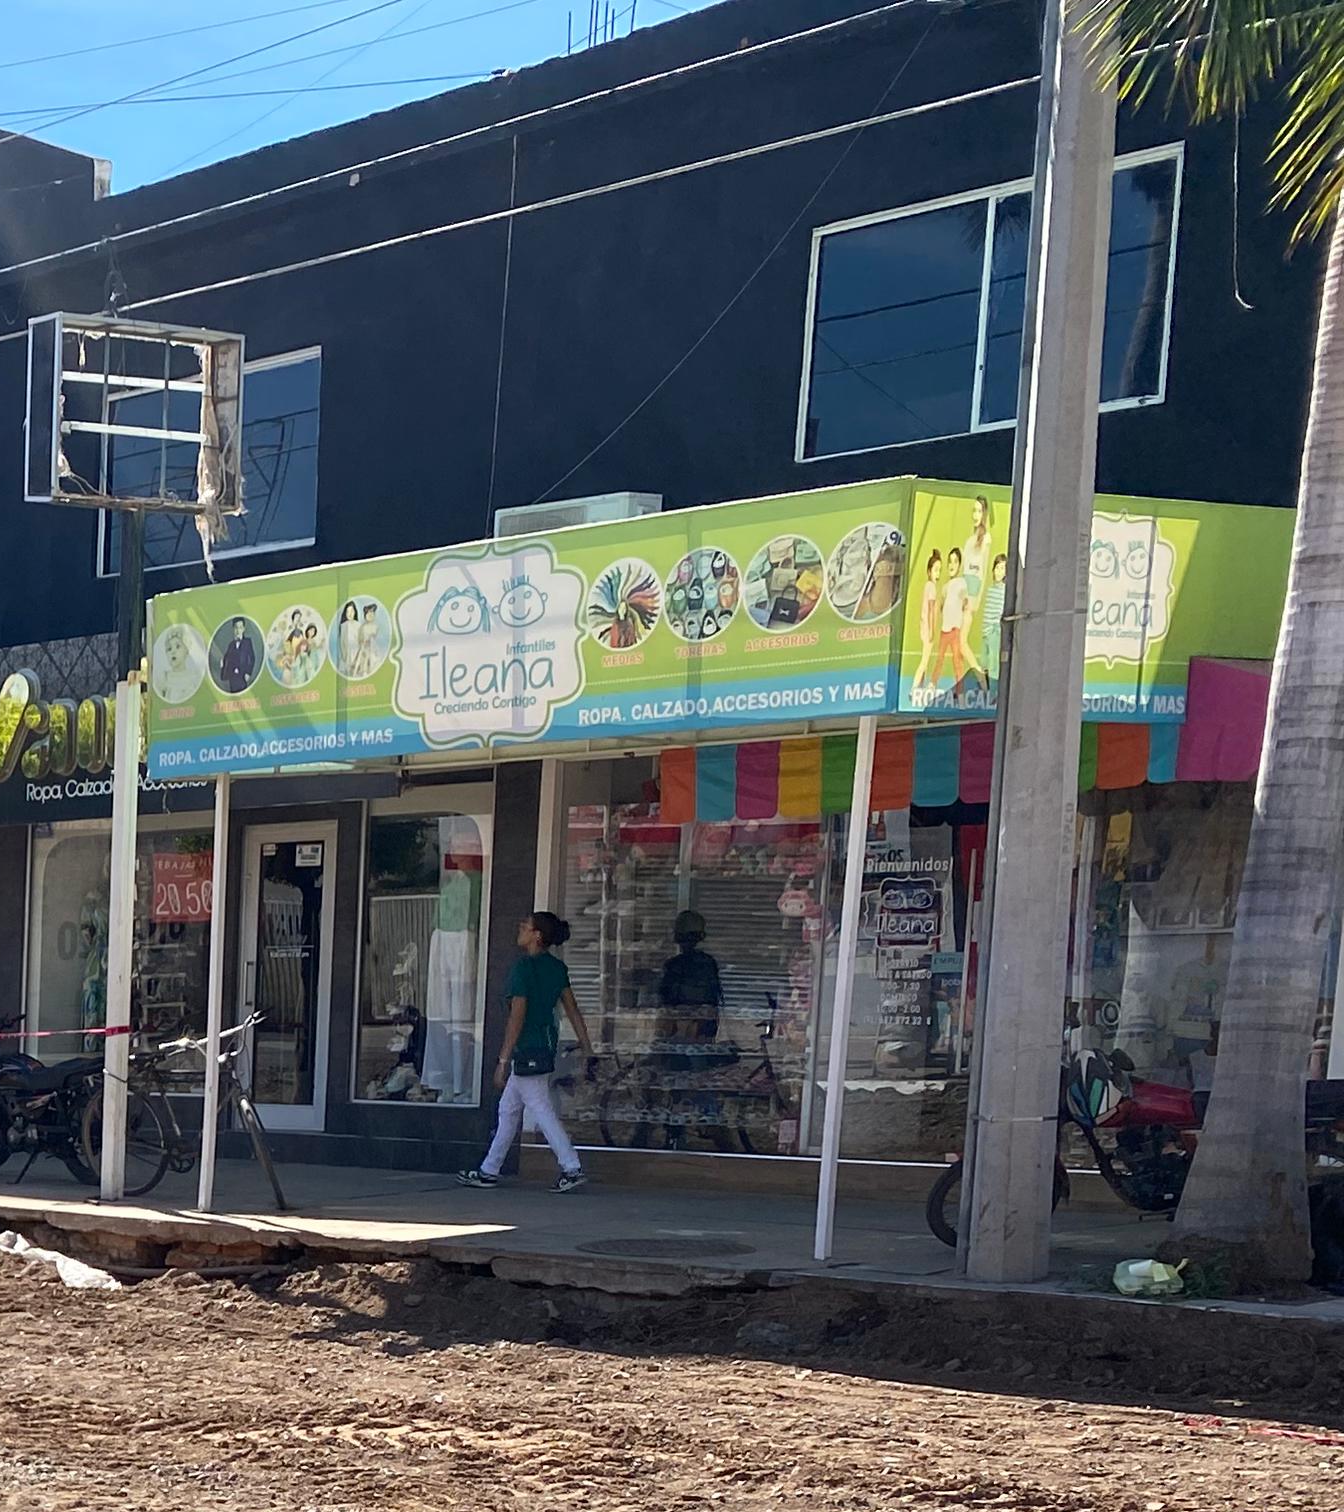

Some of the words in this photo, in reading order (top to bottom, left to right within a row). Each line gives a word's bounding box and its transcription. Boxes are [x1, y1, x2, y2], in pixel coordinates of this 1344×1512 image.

[506, 639, 556, 656] Infantiles
[745, 633, 818, 651] ACCESORIOS
[419, 645, 554, 700] Ileana
[828, 685, 840, 702] Y
[844, 680, 886, 701] MAS
[434, 698, 489, 716] Creciendo
[492, 694, 537, 712] Contigo
[1139, 695, 1150, 711] Y
[1153, 696, 1185, 715] MAS
[349, 731, 359, 746] Y
[361, 728, 393, 746] MAS
[65, 770, 114, 798] Calzad
[874, 911, 935, 933] Ileana
